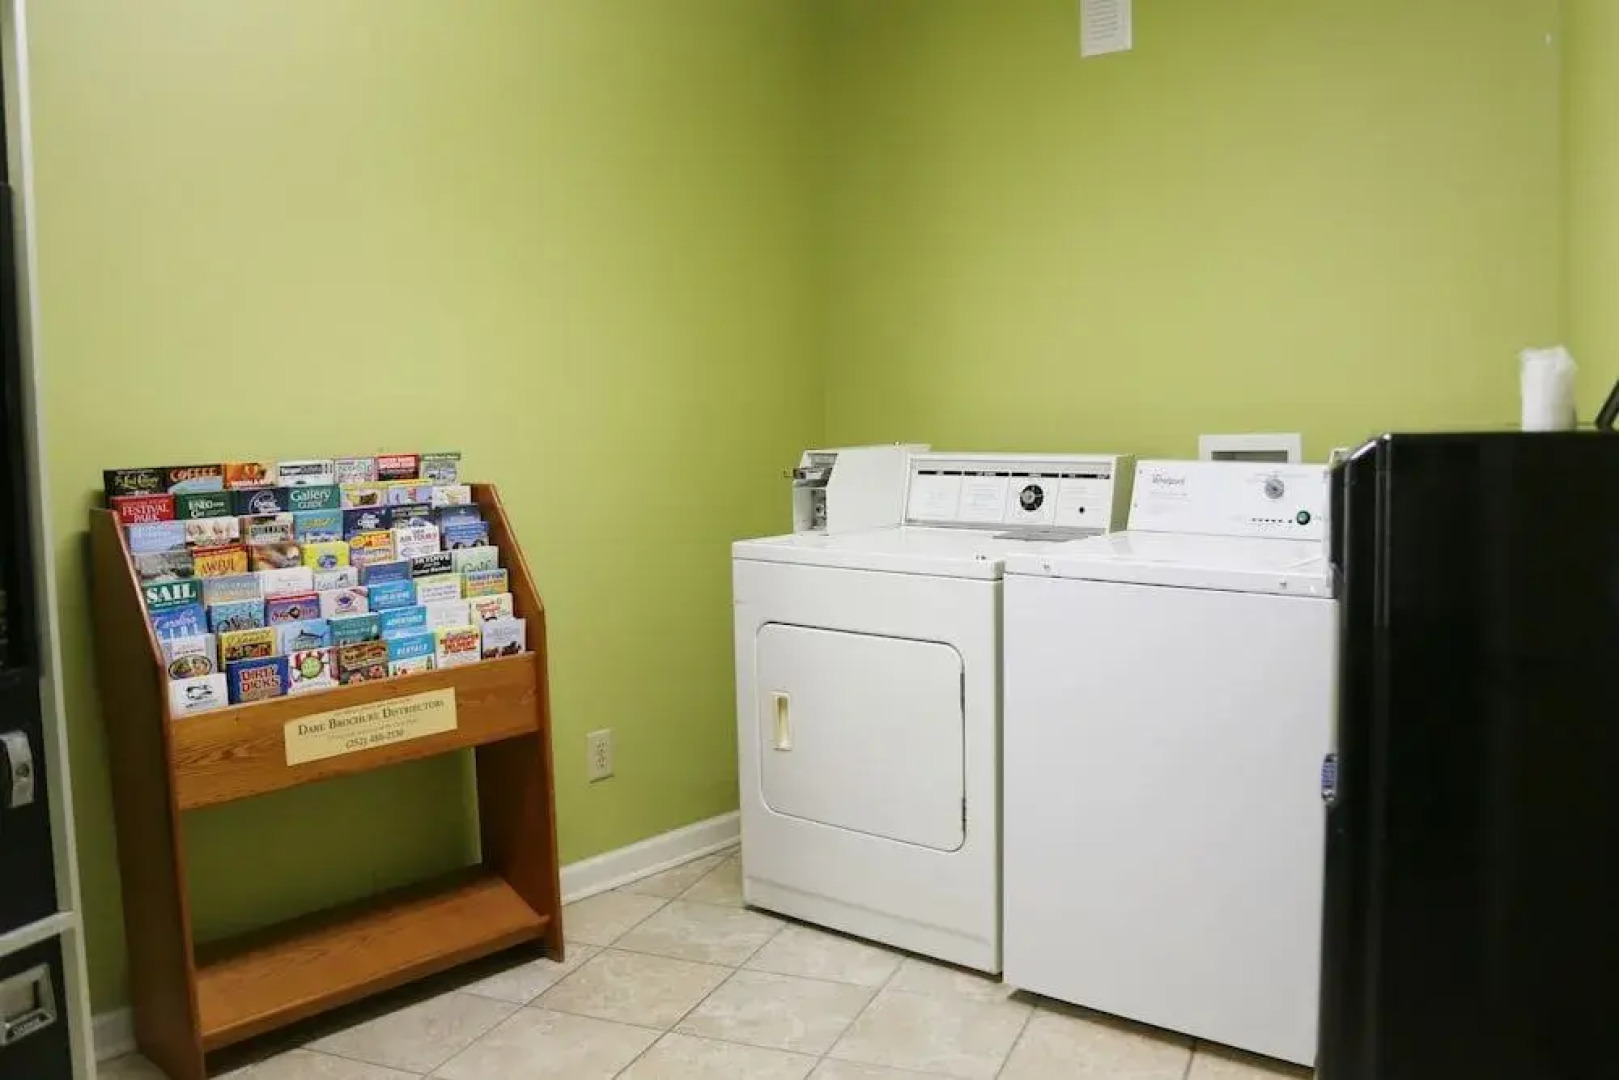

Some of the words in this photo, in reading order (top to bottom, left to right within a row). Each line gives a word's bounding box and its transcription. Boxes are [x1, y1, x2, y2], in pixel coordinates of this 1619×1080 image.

[289, 489, 332, 503] Gallery
[122, 500, 169, 517] FESTIVAL
[132, 512, 160, 523] PARK
[146, 583, 197, 603] SAIL
[240, 666, 277, 681] DIRTY
[240, 676, 281, 692] DICKS
[328, 713, 379, 730] BROCHURE
[382, 699, 445, 719] DISTRIBUTORS
